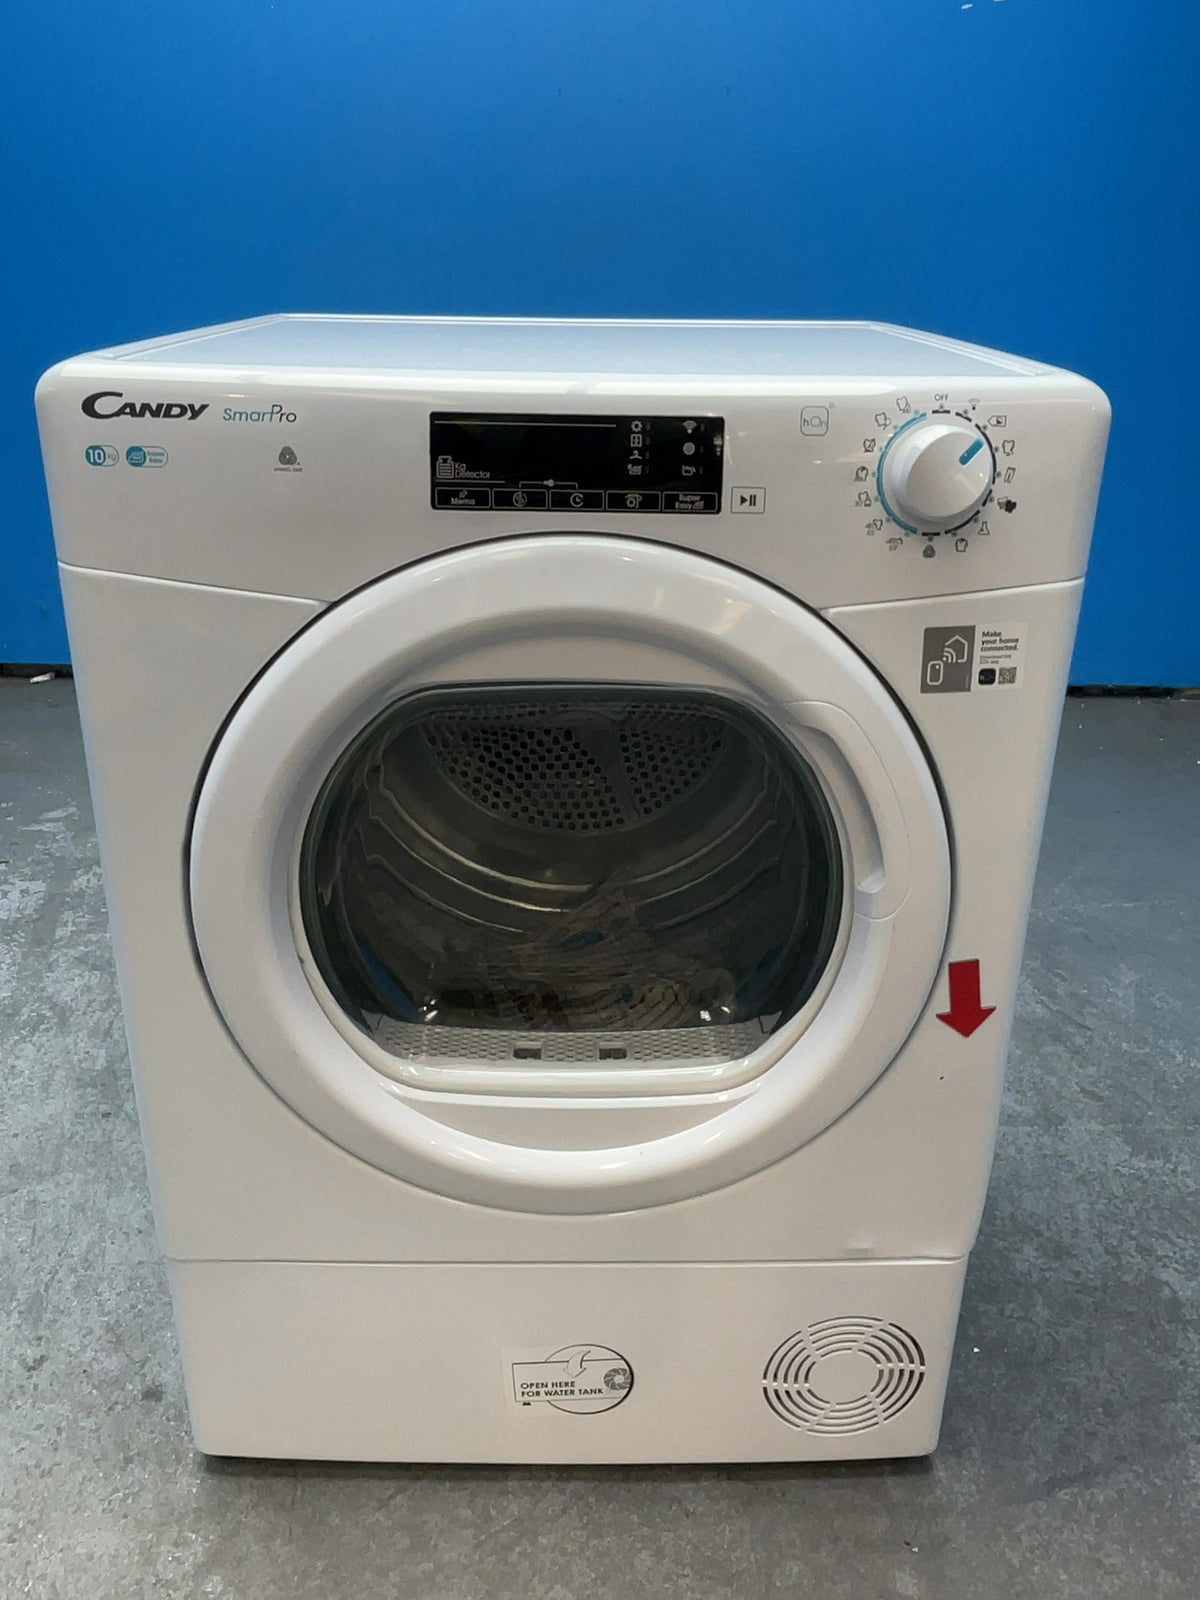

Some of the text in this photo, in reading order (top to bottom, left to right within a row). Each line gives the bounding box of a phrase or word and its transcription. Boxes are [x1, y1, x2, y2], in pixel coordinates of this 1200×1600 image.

[934, 393, 949, 401] OFF
[87, 448, 105, 464] 10
[455, 470, 491, 479] Detector
[450, 497, 476, 505] Memo
[678, 494, 701, 502] Super
[674, 501, 693, 510] Easy
[981, 630, 1002, 638] Make
[520, 1380, 576, 1390] OPEN HERE
[544, 1389, 575, 1397] WATER
[578, 1387, 604, 1395] TANK
